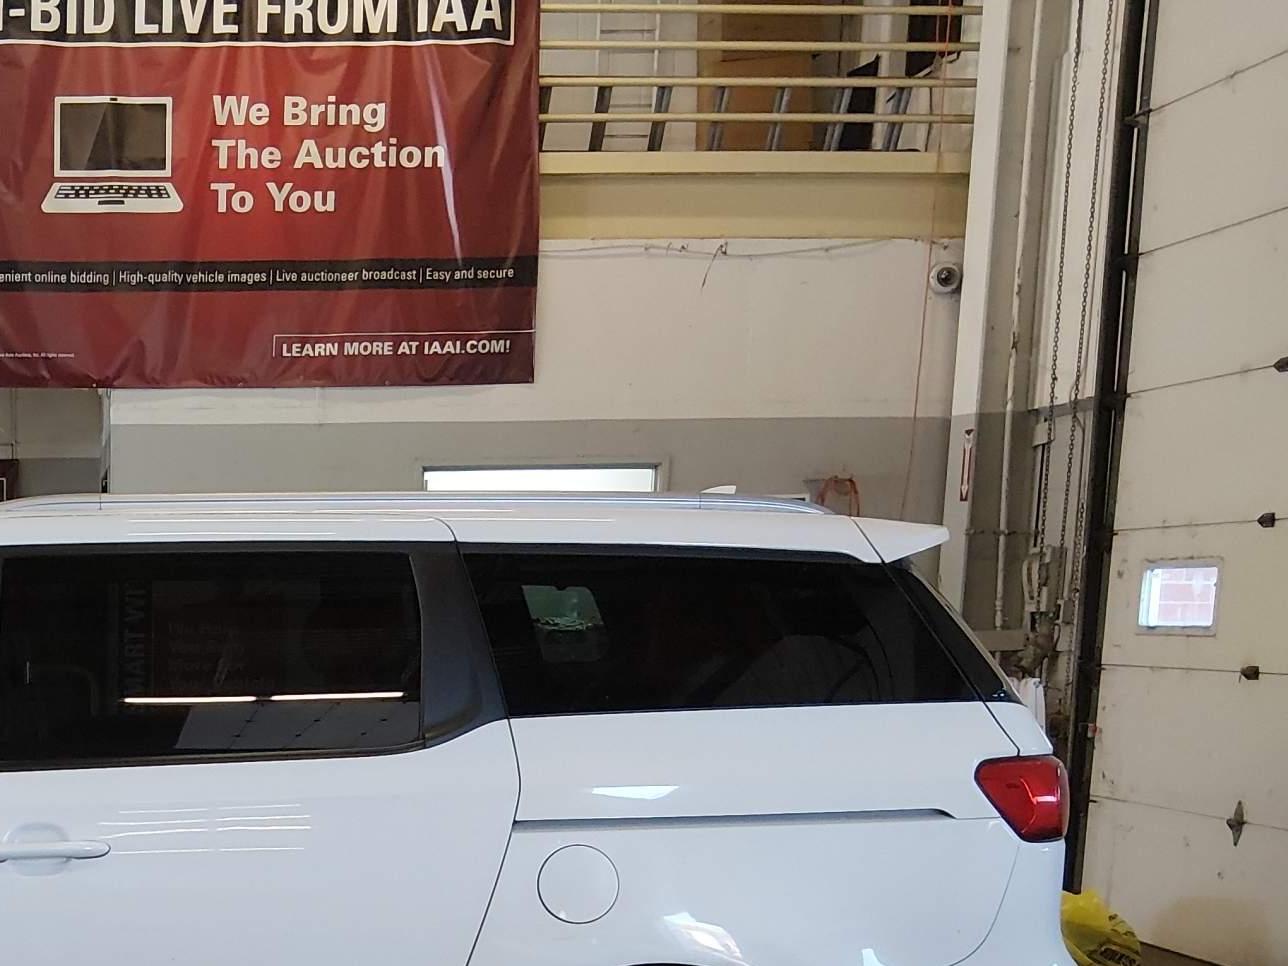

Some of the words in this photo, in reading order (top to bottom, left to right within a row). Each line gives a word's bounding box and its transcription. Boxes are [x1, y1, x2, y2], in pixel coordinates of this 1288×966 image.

[134, 0, 239, 34] LIVE
[257, 0, 398, 34] FROM
[417, 0, 503, 33] IAA
[212, 95, 270, 126] We
[283, 95, 386, 133] Bring
[211, 139, 282, 169] The
[293, 137, 446, 169] Auction
[210, 182, 255, 213] To
[265, 182, 336, 213] You
[34, 271, 67, 284] online
[69, 270, 110, 286] bidding
[118, 271, 183, 286] High-quality
[186, 271, 225, 284] vehicle
[227, 271, 267, 286] images
[276, 270, 298, 282] Live
[300, 269, 359, 282] auctioneer
[362, 268, 417, 281] broadcast
[425, 267, 452, 283] Easy
[454, 267, 474, 280] and
[476, 267, 514, 280] secure
[282, 343, 339, 357] LEARN
[343, 342, 394, 356] MORE
[397, 341, 420, 355] AT
[423, 339, 511, 355] IAAI.COM!
